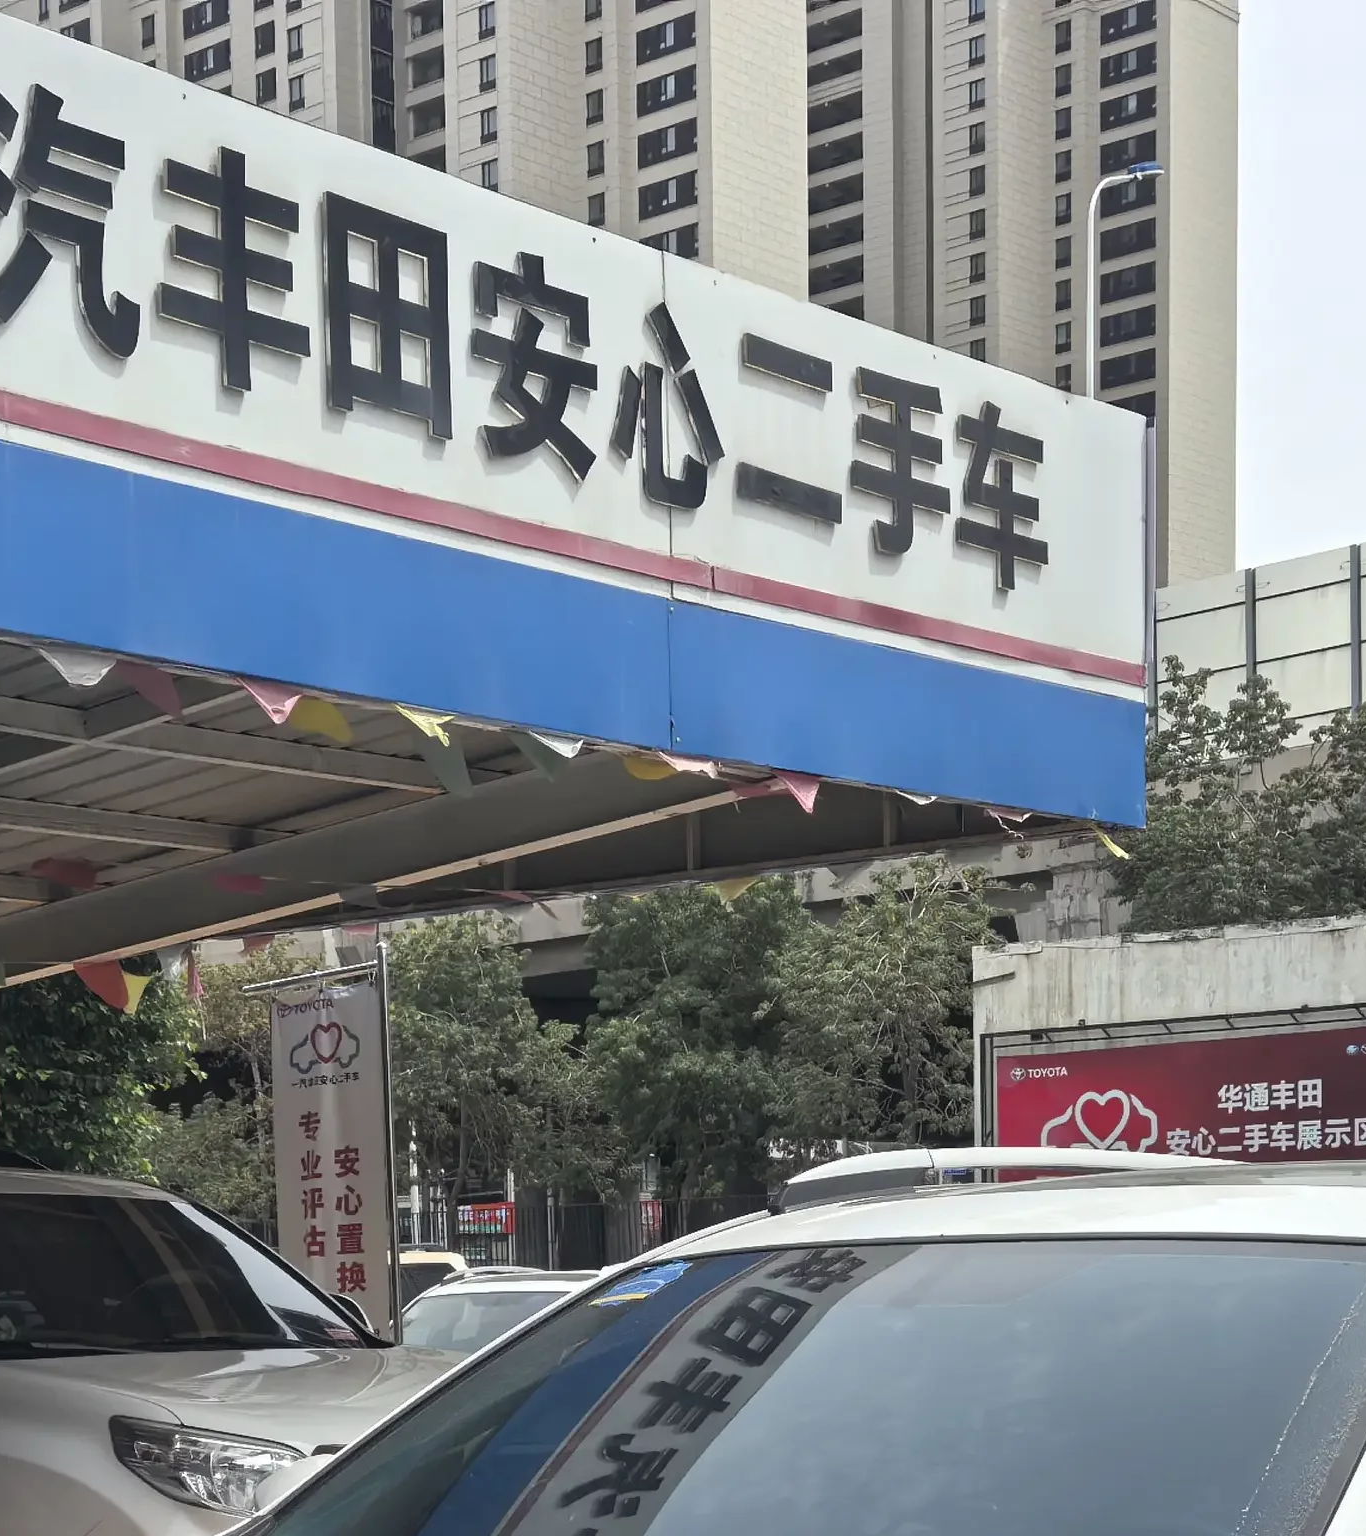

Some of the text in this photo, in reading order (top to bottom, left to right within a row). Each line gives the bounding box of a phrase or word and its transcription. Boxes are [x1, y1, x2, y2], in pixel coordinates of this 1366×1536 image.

[1027, 1065, 1068, 1080] TOYOTA
[1216, 1078, 1324, 1115] 华通丰田
[298, 1109, 327, 1259] 专业评估
[334, 1144, 367, 1294] 安心置换
